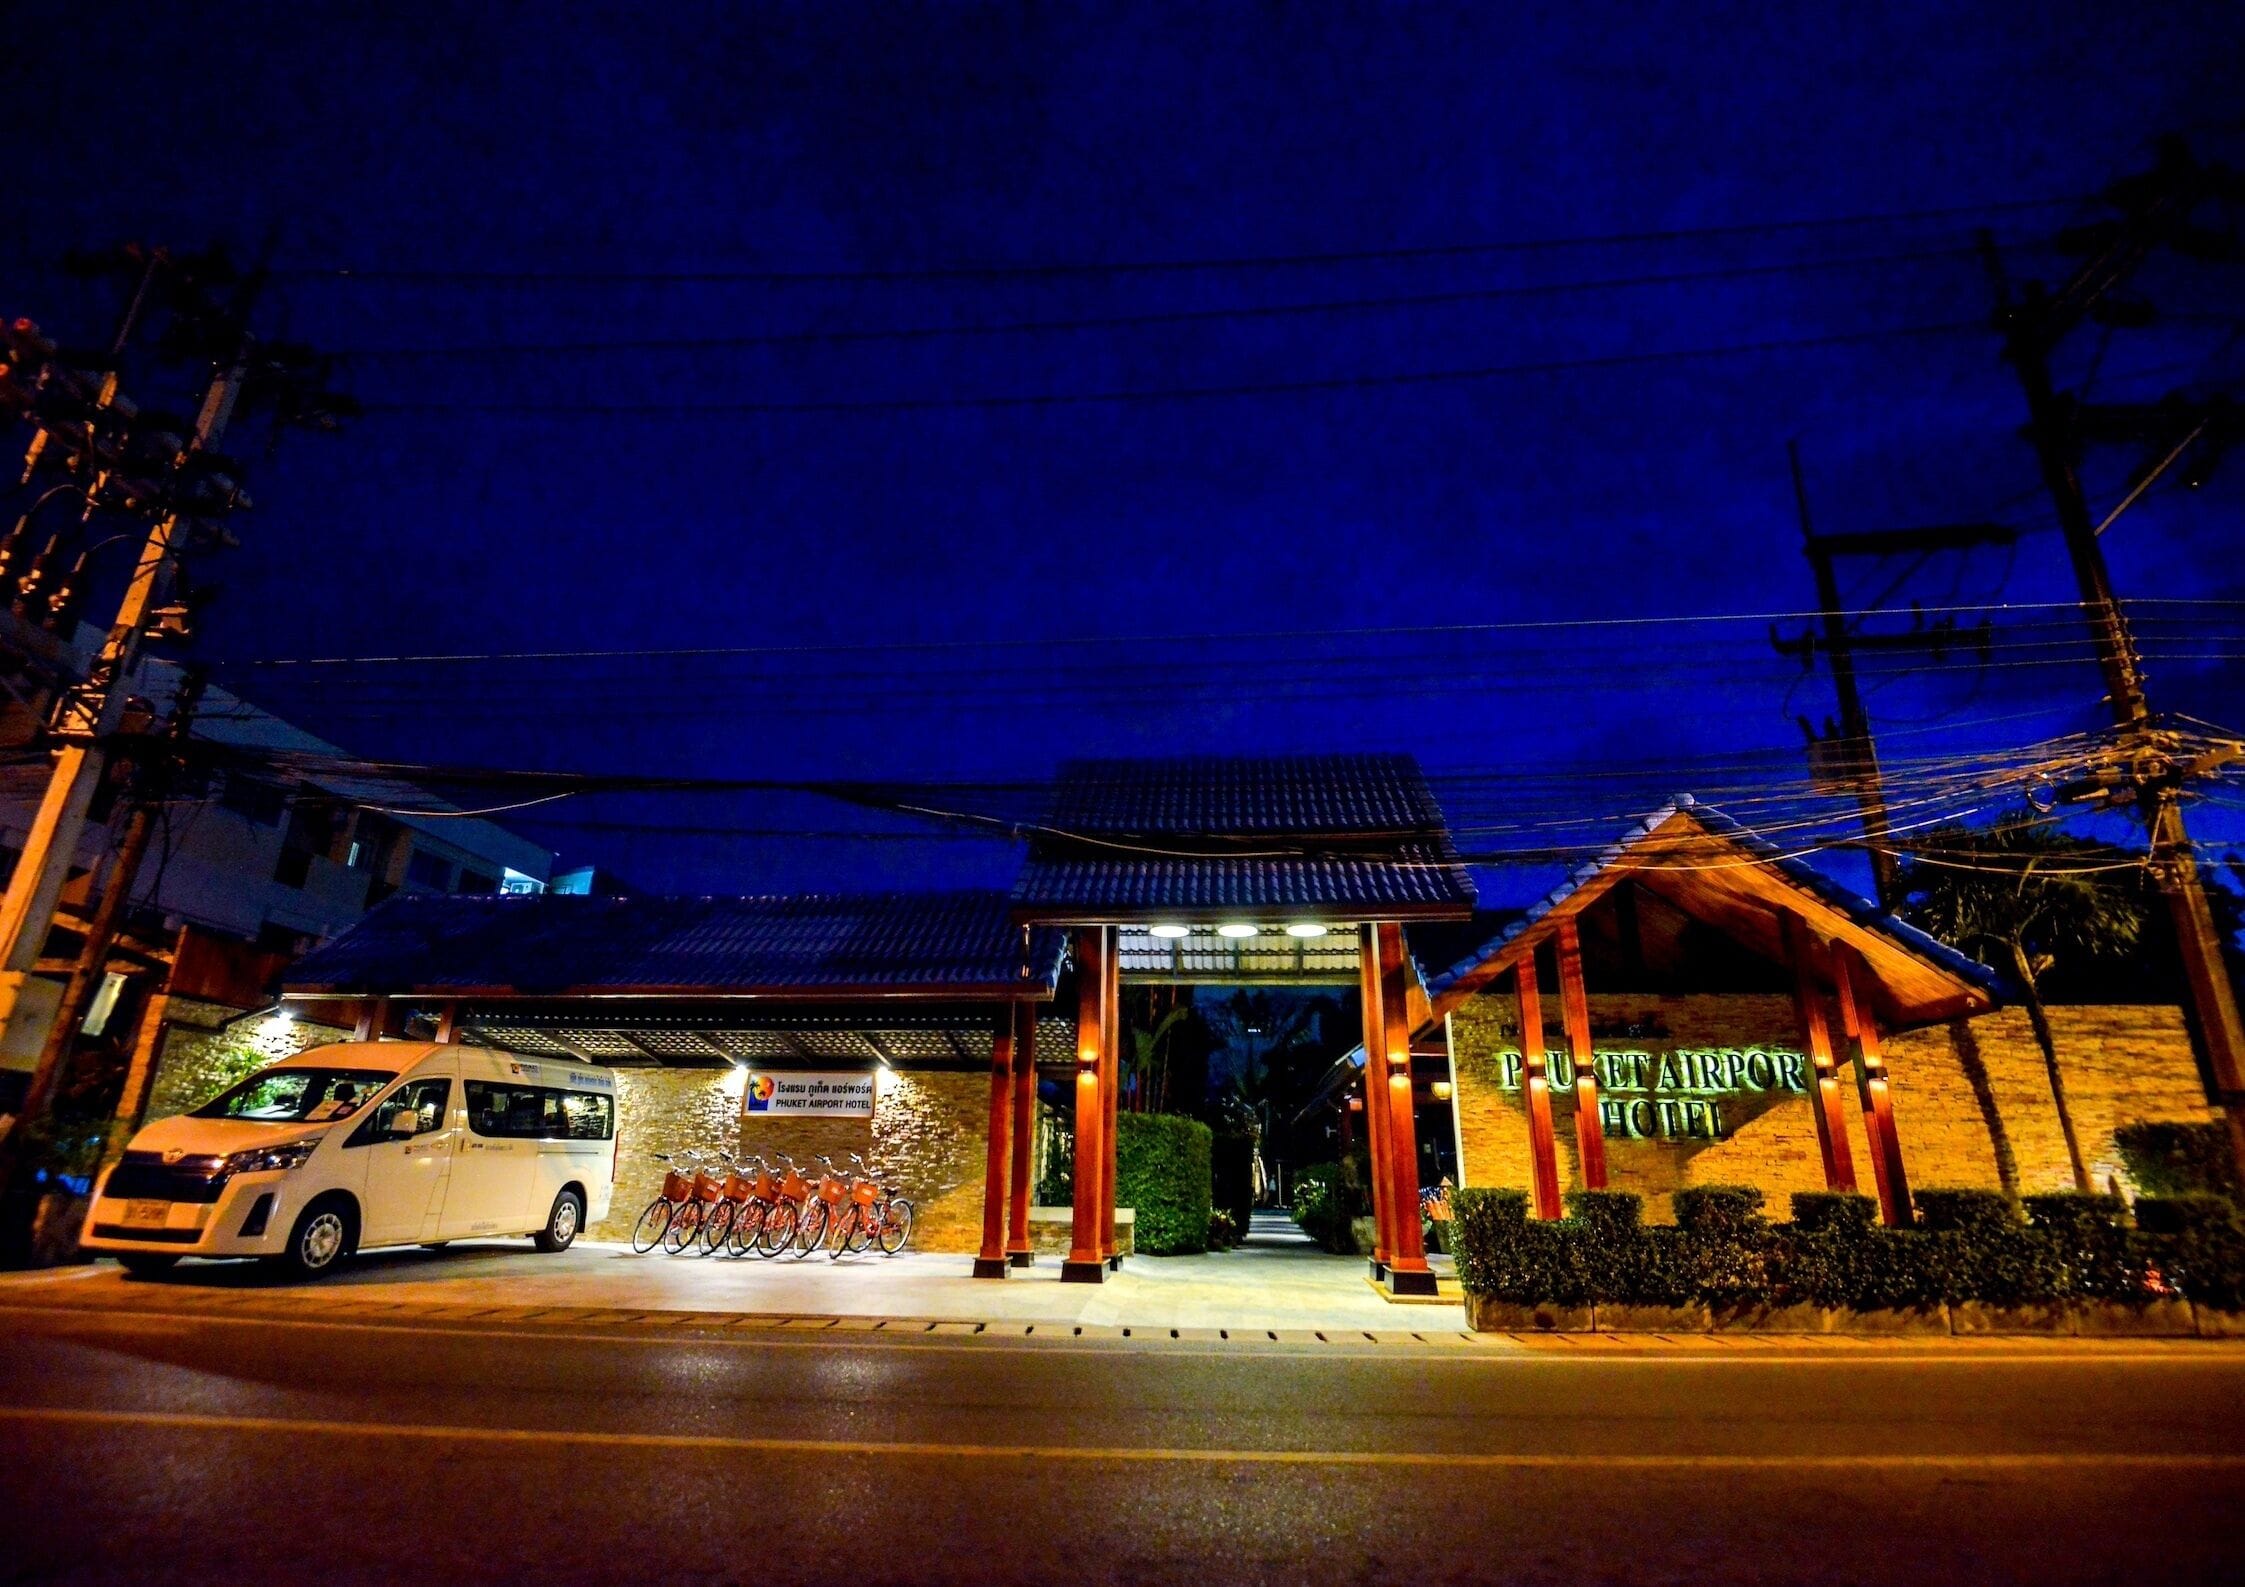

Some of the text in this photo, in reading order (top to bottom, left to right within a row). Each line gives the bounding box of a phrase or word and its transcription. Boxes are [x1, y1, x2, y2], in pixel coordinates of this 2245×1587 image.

[1504, 1052, 1810, 1090] PUET AIRPOR
[777, 1080, 872, 1097] โรงแรม ภูเก็ต แอร์พอร์ต
[775, 1099, 871, 1109] PHUKET AIRPORT HOTEL
